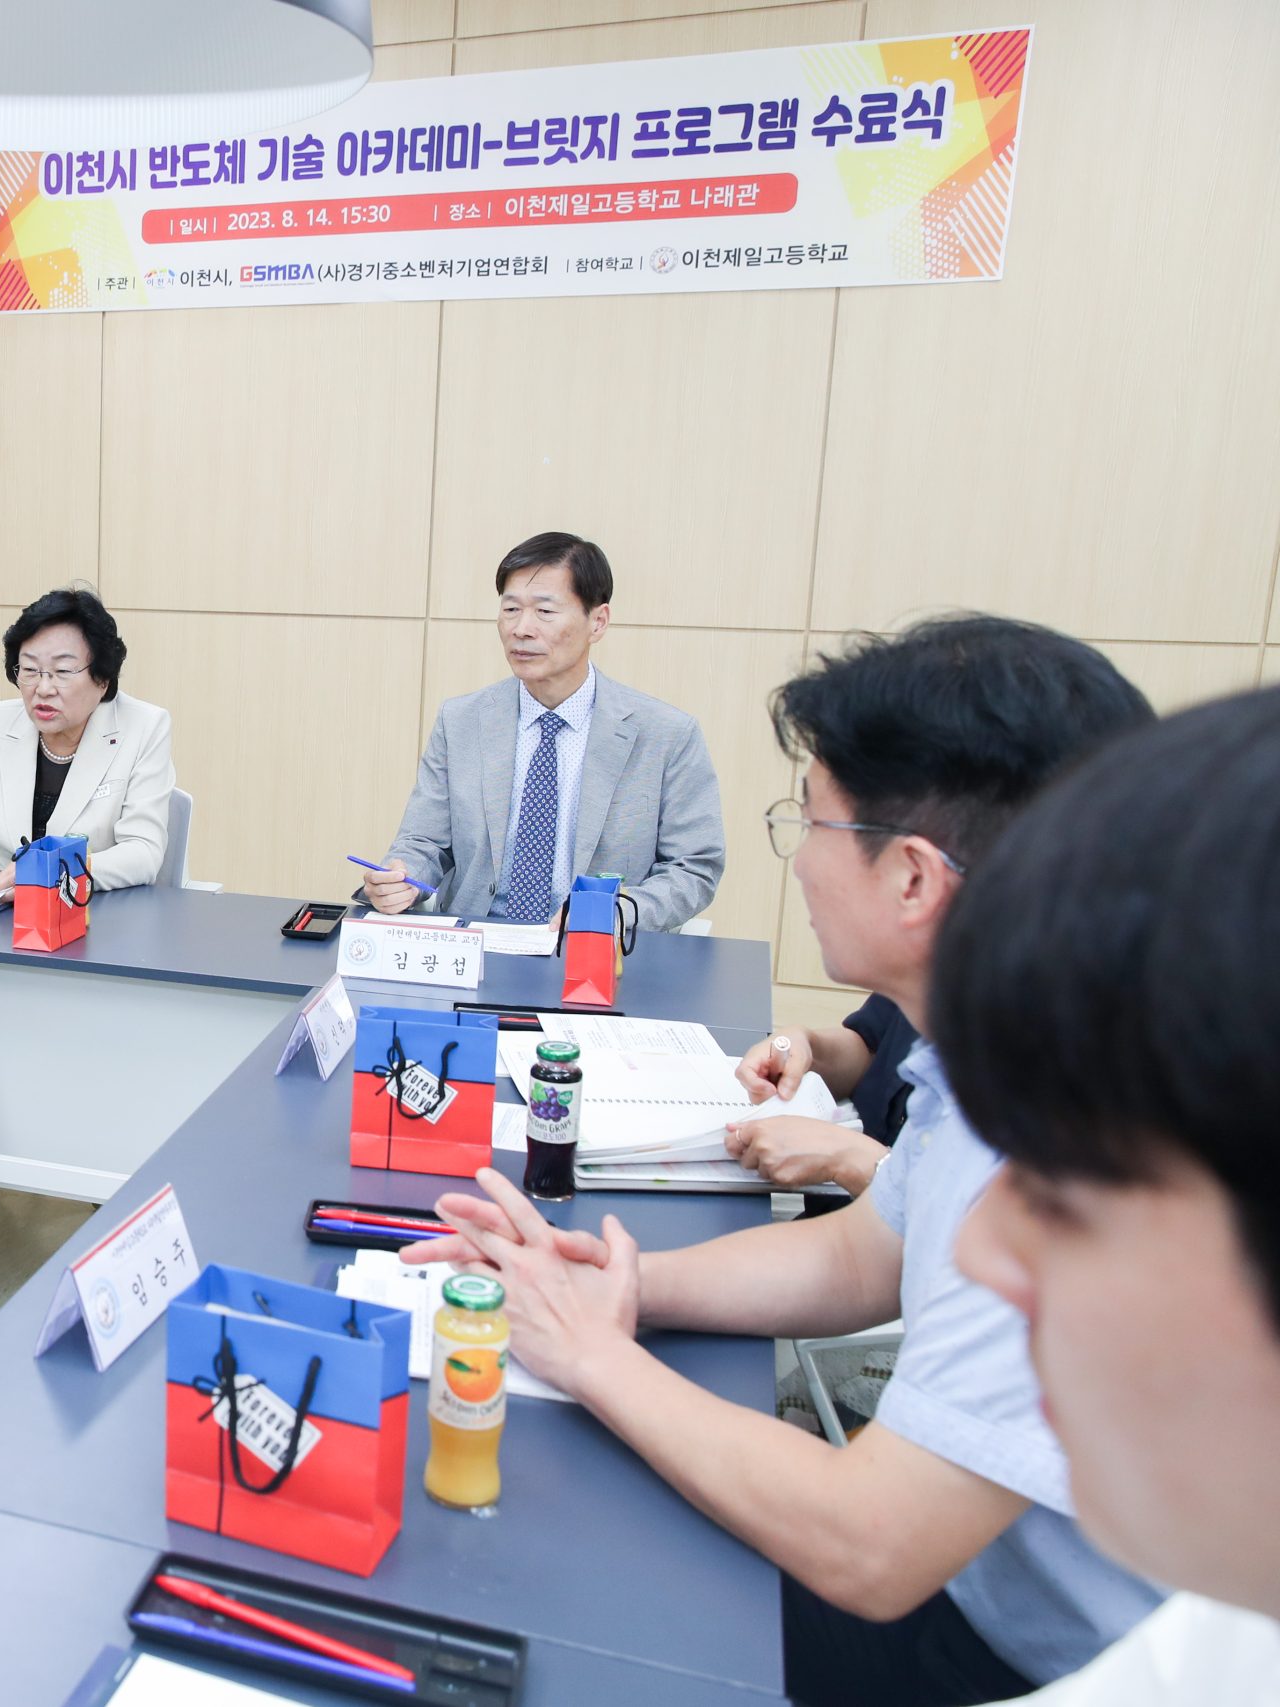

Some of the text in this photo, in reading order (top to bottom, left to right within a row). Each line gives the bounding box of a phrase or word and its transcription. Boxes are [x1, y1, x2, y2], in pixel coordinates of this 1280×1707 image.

[43, 86, 946, 195] 이천시 반도체 기술 아카데미-브릿지 프로그램 수료식
[227, 212, 276, 231] 2023.
[281, 209, 298, 228] 8.
[306, 208, 333, 226] 14.
[341, 204, 391, 224] 15:30
[505, 188, 681, 219] 이천제일고등학교
[690, 182, 760, 209] 나래관
[180, 268, 233, 287] 이천시,
[317, 255, 549, 282] (사)경기중소벤처기업연합회
[681, 243, 848, 269] 이천제일고등학교
